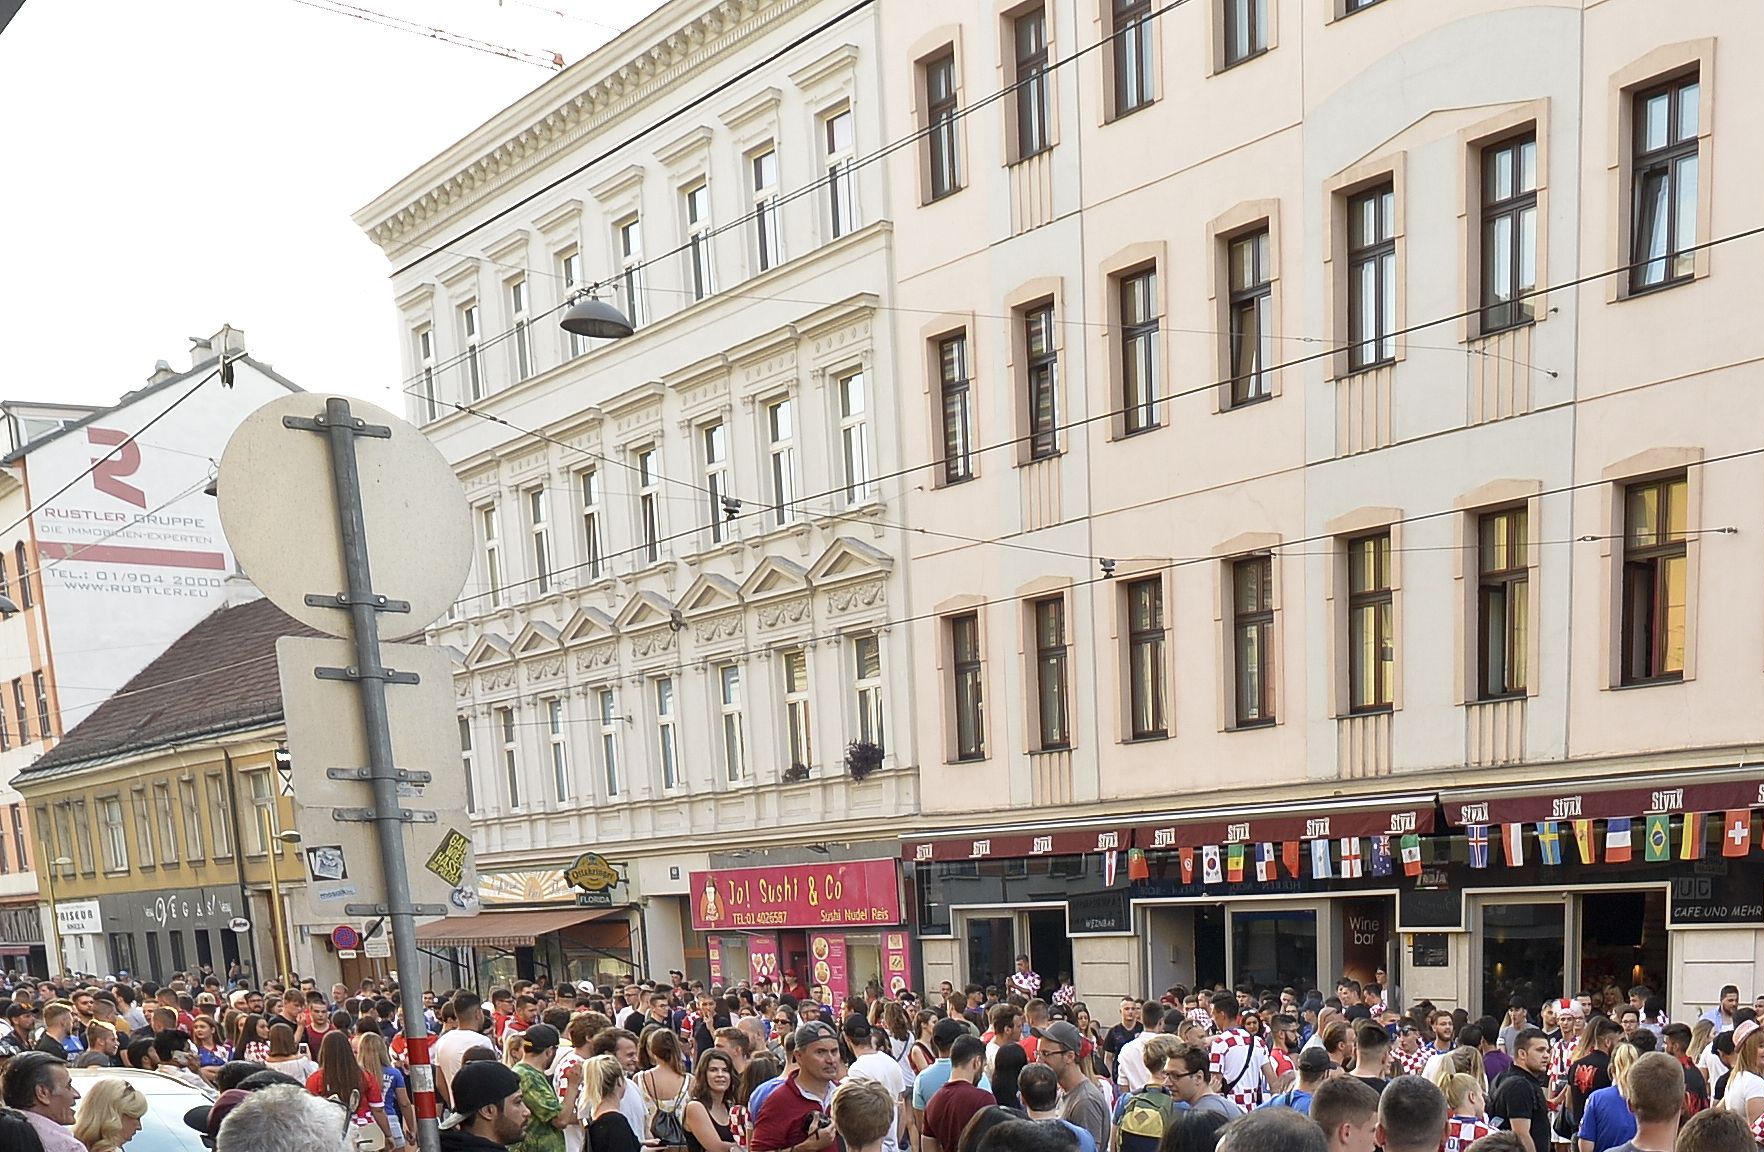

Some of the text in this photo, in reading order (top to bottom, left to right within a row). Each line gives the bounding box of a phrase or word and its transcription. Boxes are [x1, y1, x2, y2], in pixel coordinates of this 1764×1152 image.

[44, 507, 205, 528] RUSTLER GRUPPE
[41, 525, 213, 544] DIE IMMOBILIEN-EXPERTEN
[96, 571, 164, 583] 01/904
[172, 575, 221, 588] 2000
[64, 582, 209, 598] WWW.RUSTLER.EU
[728, 874, 842, 908] Jo! Sushi & Co
[57, 910, 93, 921] RISEUR
[820, 907, 889, 923] Sushi Nudel Reis
[1674, 904, 1763, 918] CAFE UND MEHR
[1349, 917, 1380, 932] Wine
[1354, 931, 1376, 946] bar
